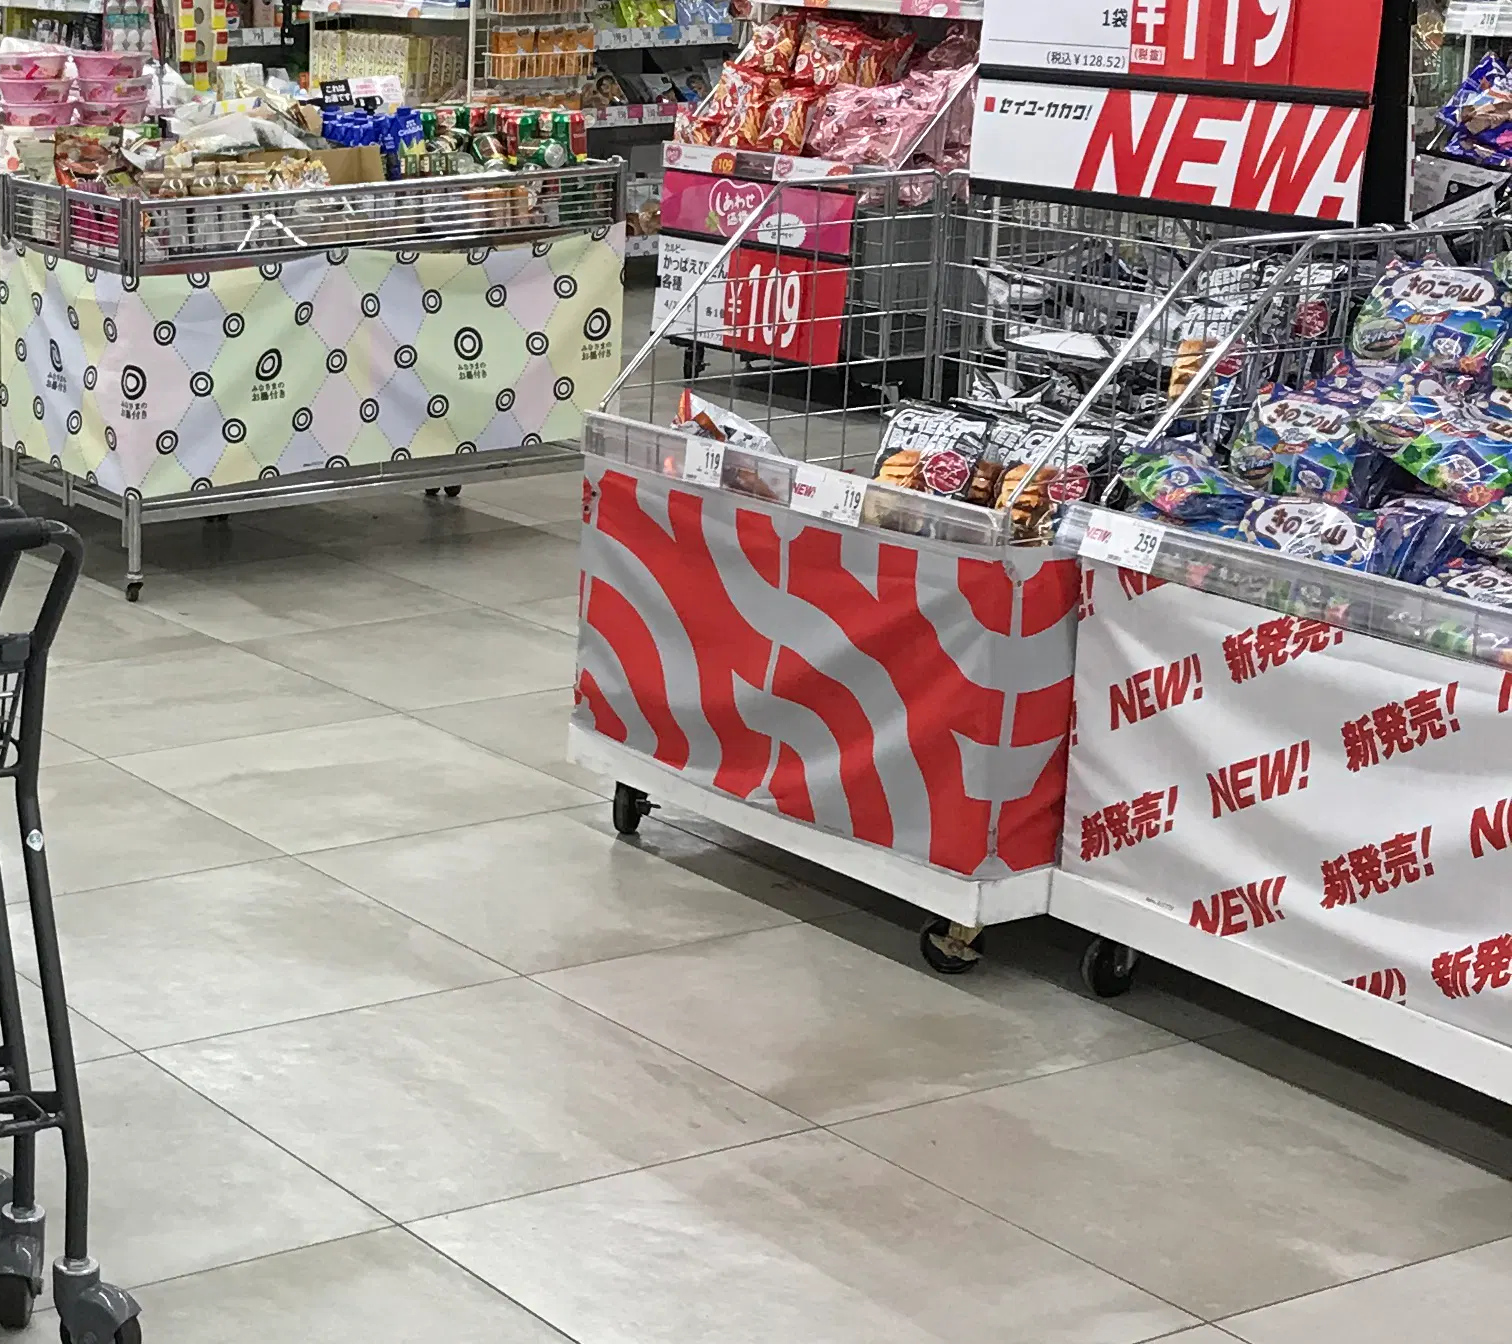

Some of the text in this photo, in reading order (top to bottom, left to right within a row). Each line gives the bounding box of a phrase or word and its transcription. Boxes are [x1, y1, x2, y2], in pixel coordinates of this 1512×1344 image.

[1102, 8, 1129, 29] 1袋
[662, 275, 682, 291] 各種
[1402, 272, 1486, 304] きのこの山
[704, 452, 721, 470] 119
[792, 481, 817, 498] NEW!
[844, 491, 862, 509] 119
[1086, 525, 1112, 544] NEW!
[1133, 532, 1158, 554] 259
[1109, 653, 1203, 731] NEW!
[1341, 681, 1461, 773] 新発売!
[1206, 739, 1311, 819] NEW!
[1080, 784, 1179, 863] 新発売!
[1319, 825, 1435, 910] 新発売!
[1189, 875, 1288, 937] NEW!
